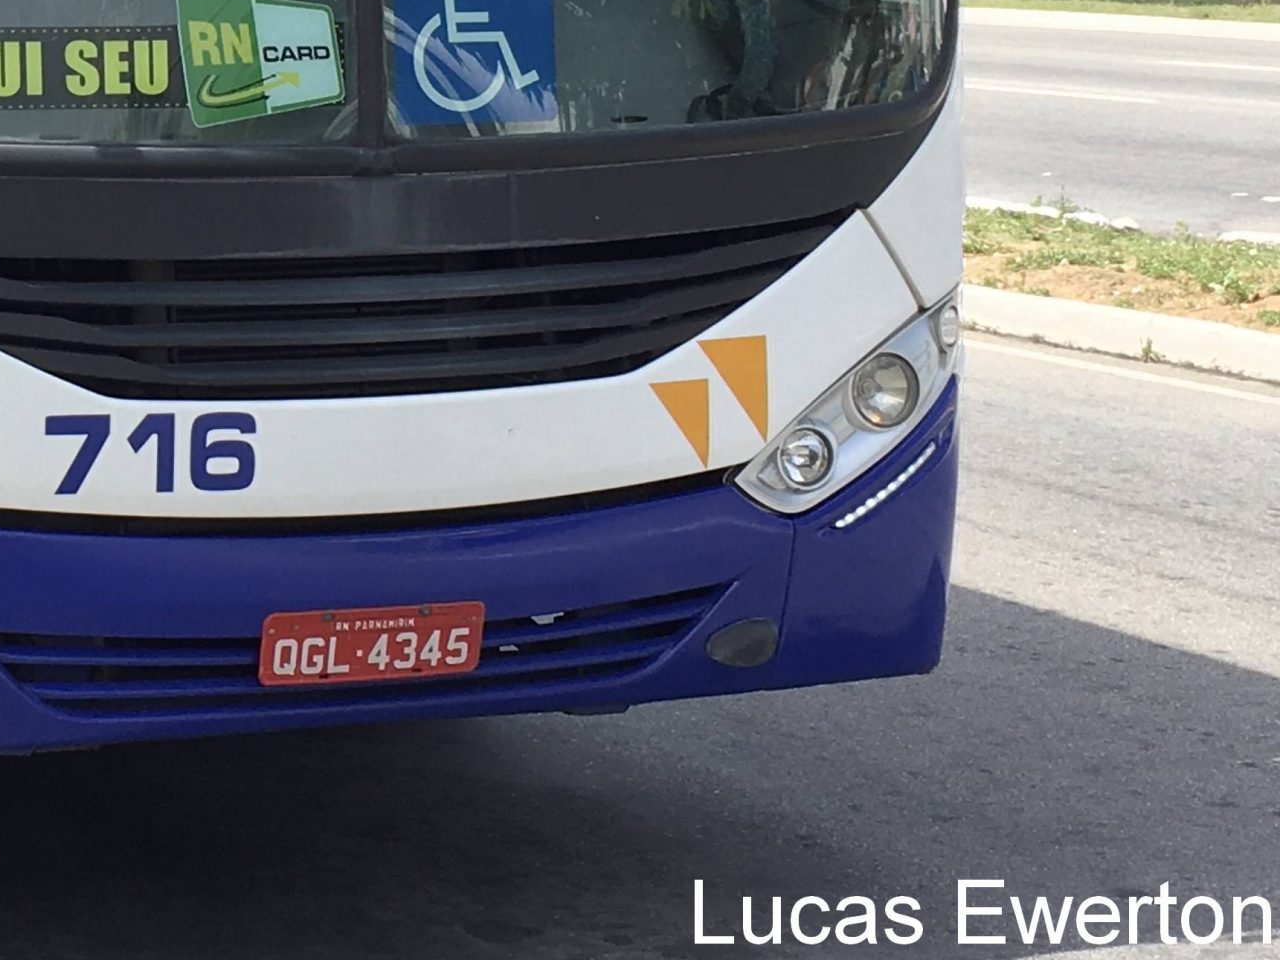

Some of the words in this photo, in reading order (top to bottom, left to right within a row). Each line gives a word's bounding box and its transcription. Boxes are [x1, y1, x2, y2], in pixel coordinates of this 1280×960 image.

[64, 39, 168, 97] SEU
[189, 21, 254, 67] RN
[263, 44, 331, 63] CARD
[45, 411, 257, 495] 716
[354, 618, 416, 631] PARNAMIRIM
